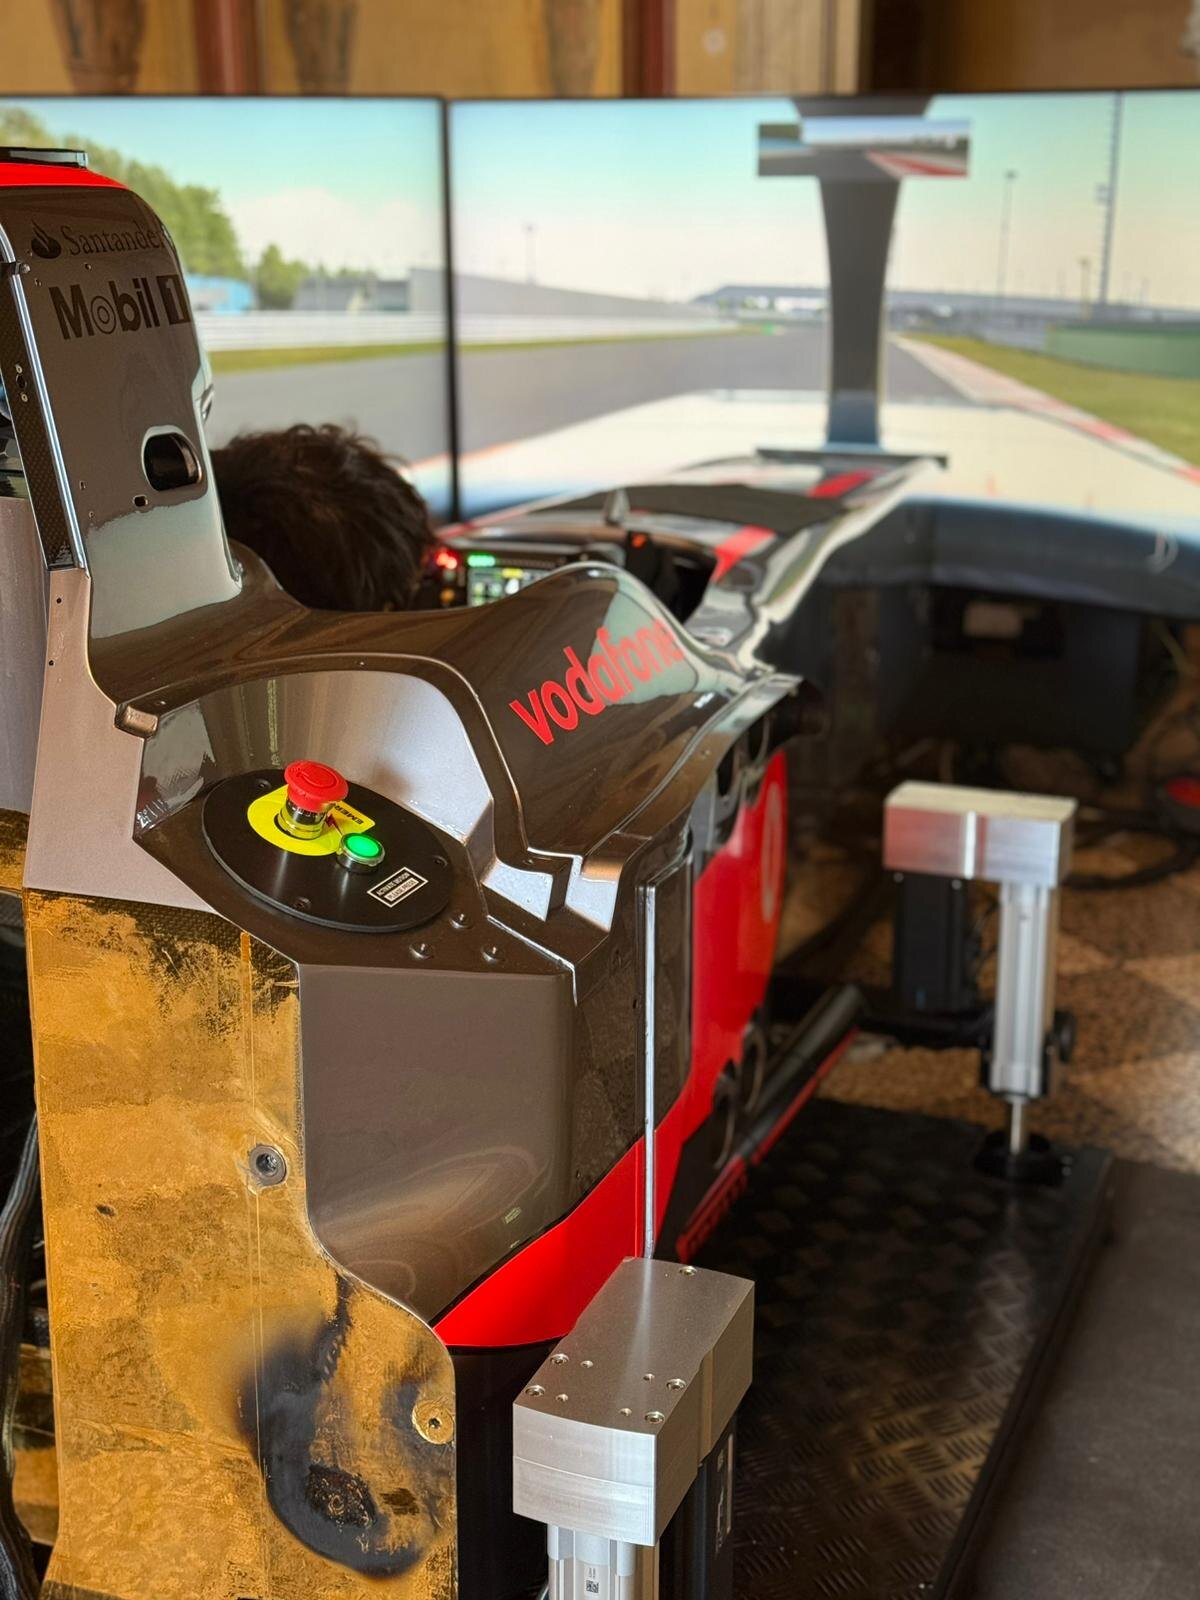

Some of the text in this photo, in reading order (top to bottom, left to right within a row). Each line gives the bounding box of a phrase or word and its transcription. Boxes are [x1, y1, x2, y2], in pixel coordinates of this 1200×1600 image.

[60, 219, 166, 255] Santander
[49, 277, 160, 340] Mobil
[335, 805, 365, 825] EMER
